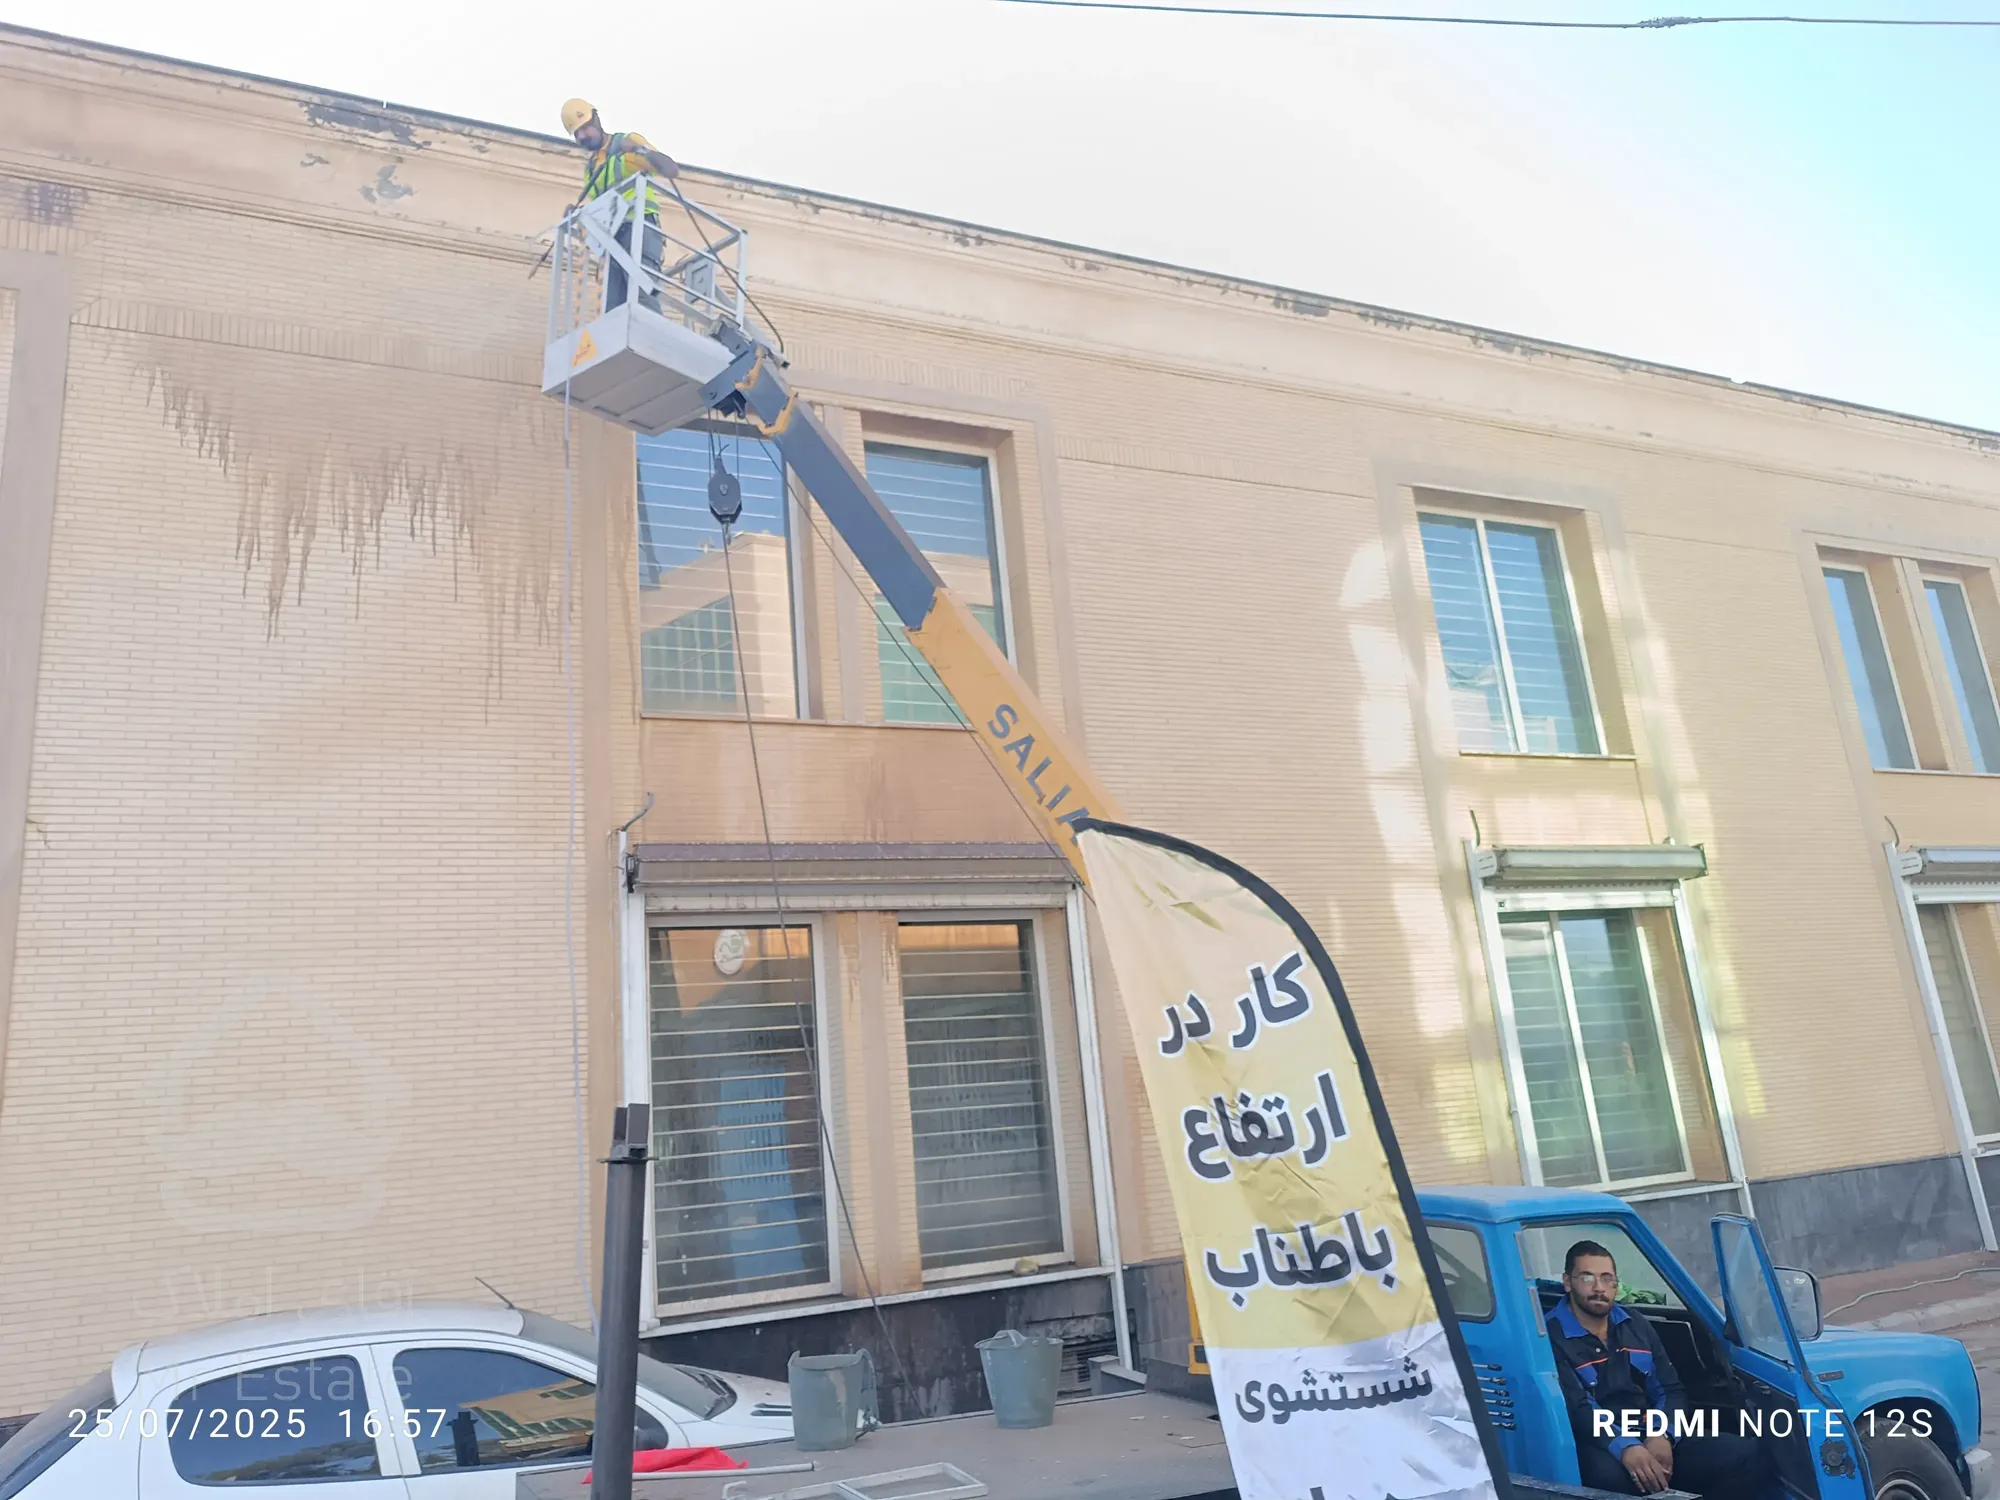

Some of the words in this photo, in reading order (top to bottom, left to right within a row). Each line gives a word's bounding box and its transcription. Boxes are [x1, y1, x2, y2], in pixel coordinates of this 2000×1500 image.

[1160, 994, 1211, 1054] در
[1231, 952, 1310, 1048] کار
[1184, 1073, 1347, 1179] ارتفاع
[1235, 1356, 1434, 1425] شستشوی
